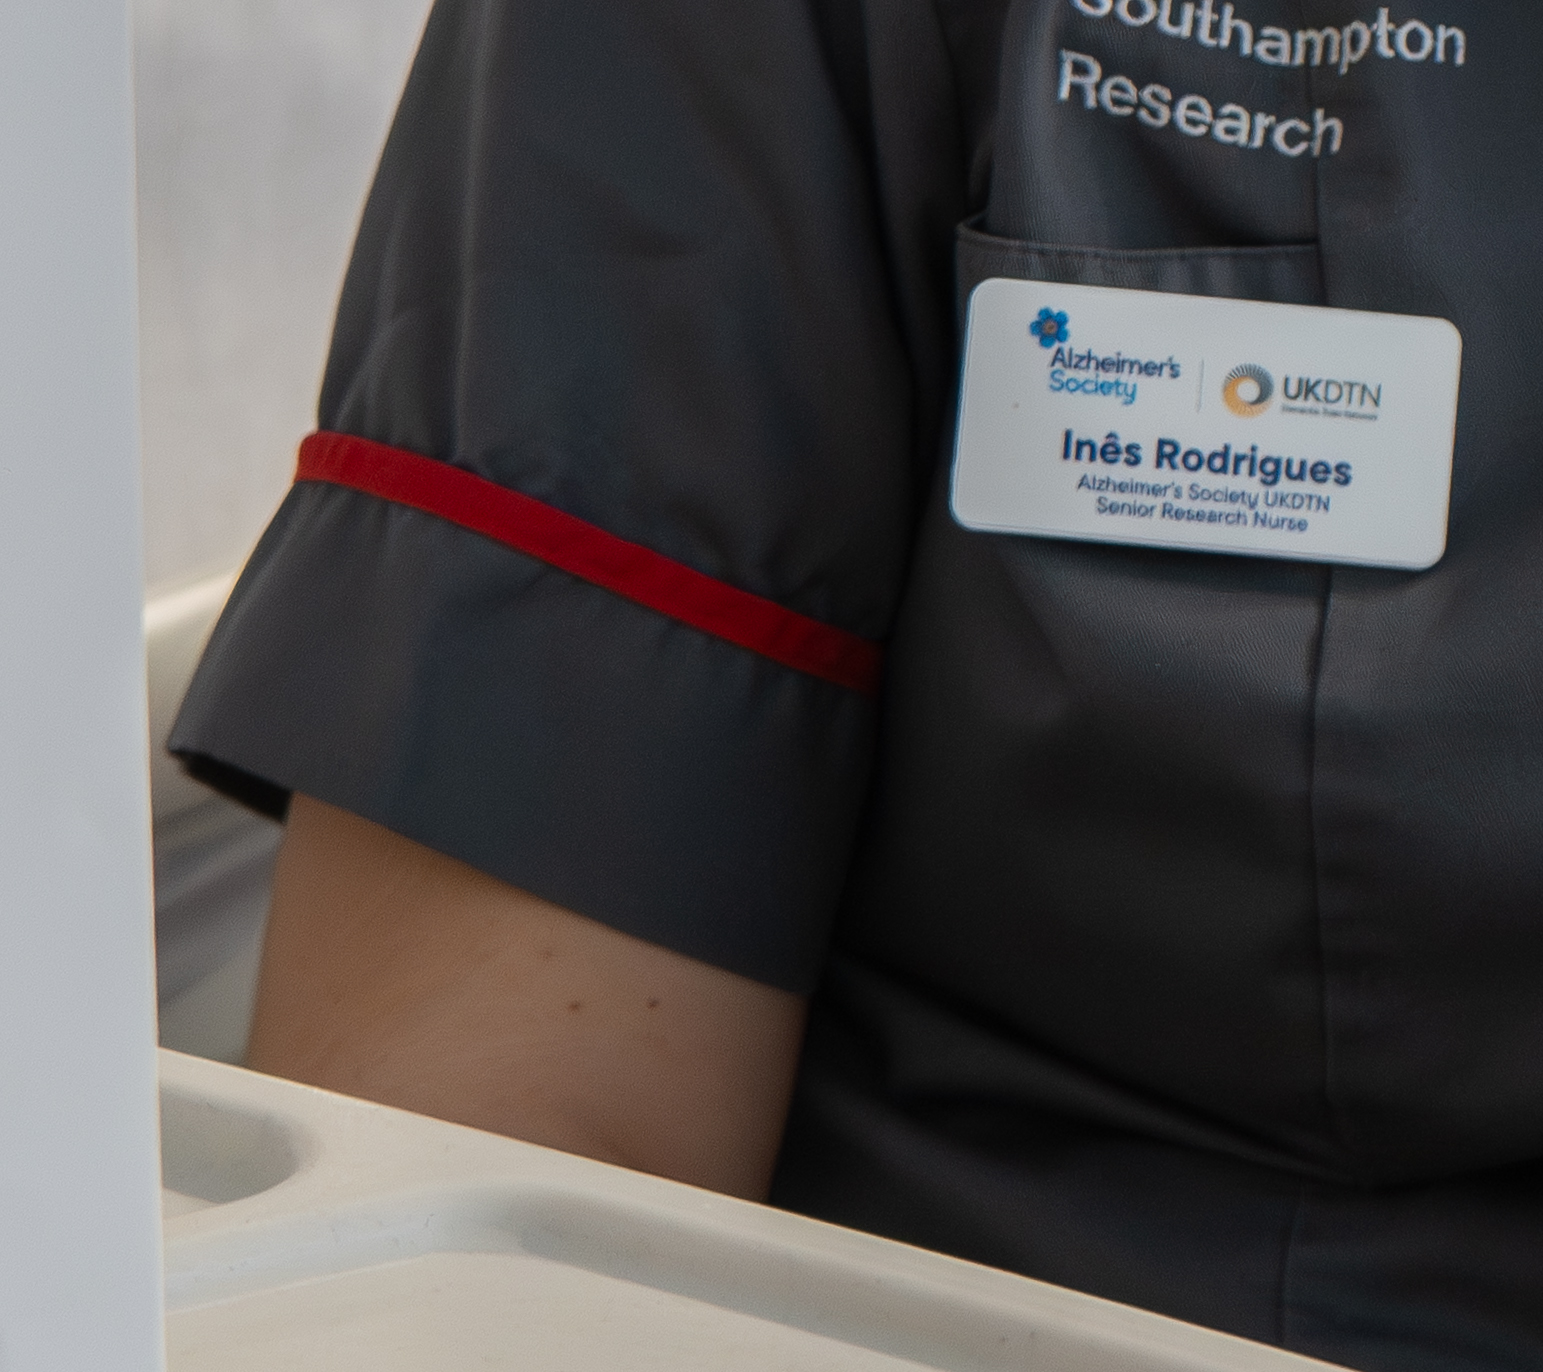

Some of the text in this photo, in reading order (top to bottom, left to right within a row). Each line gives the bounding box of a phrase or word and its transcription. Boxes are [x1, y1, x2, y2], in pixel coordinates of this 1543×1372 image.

[1057, 48, 1344, 157] Research
[1050, 346, 1181, 379] Alzheimer's
[1049, 368, 1138, 406] Society
[1283, 375, 1382, 407] UKDTN
[1062, 428, 1353, 486] Inês Rodrigues
[1077, 473, 1331, 512] Alzheimer's Society UKDTN
[1097, 496, 1308, 532] Senior Research Nurse
